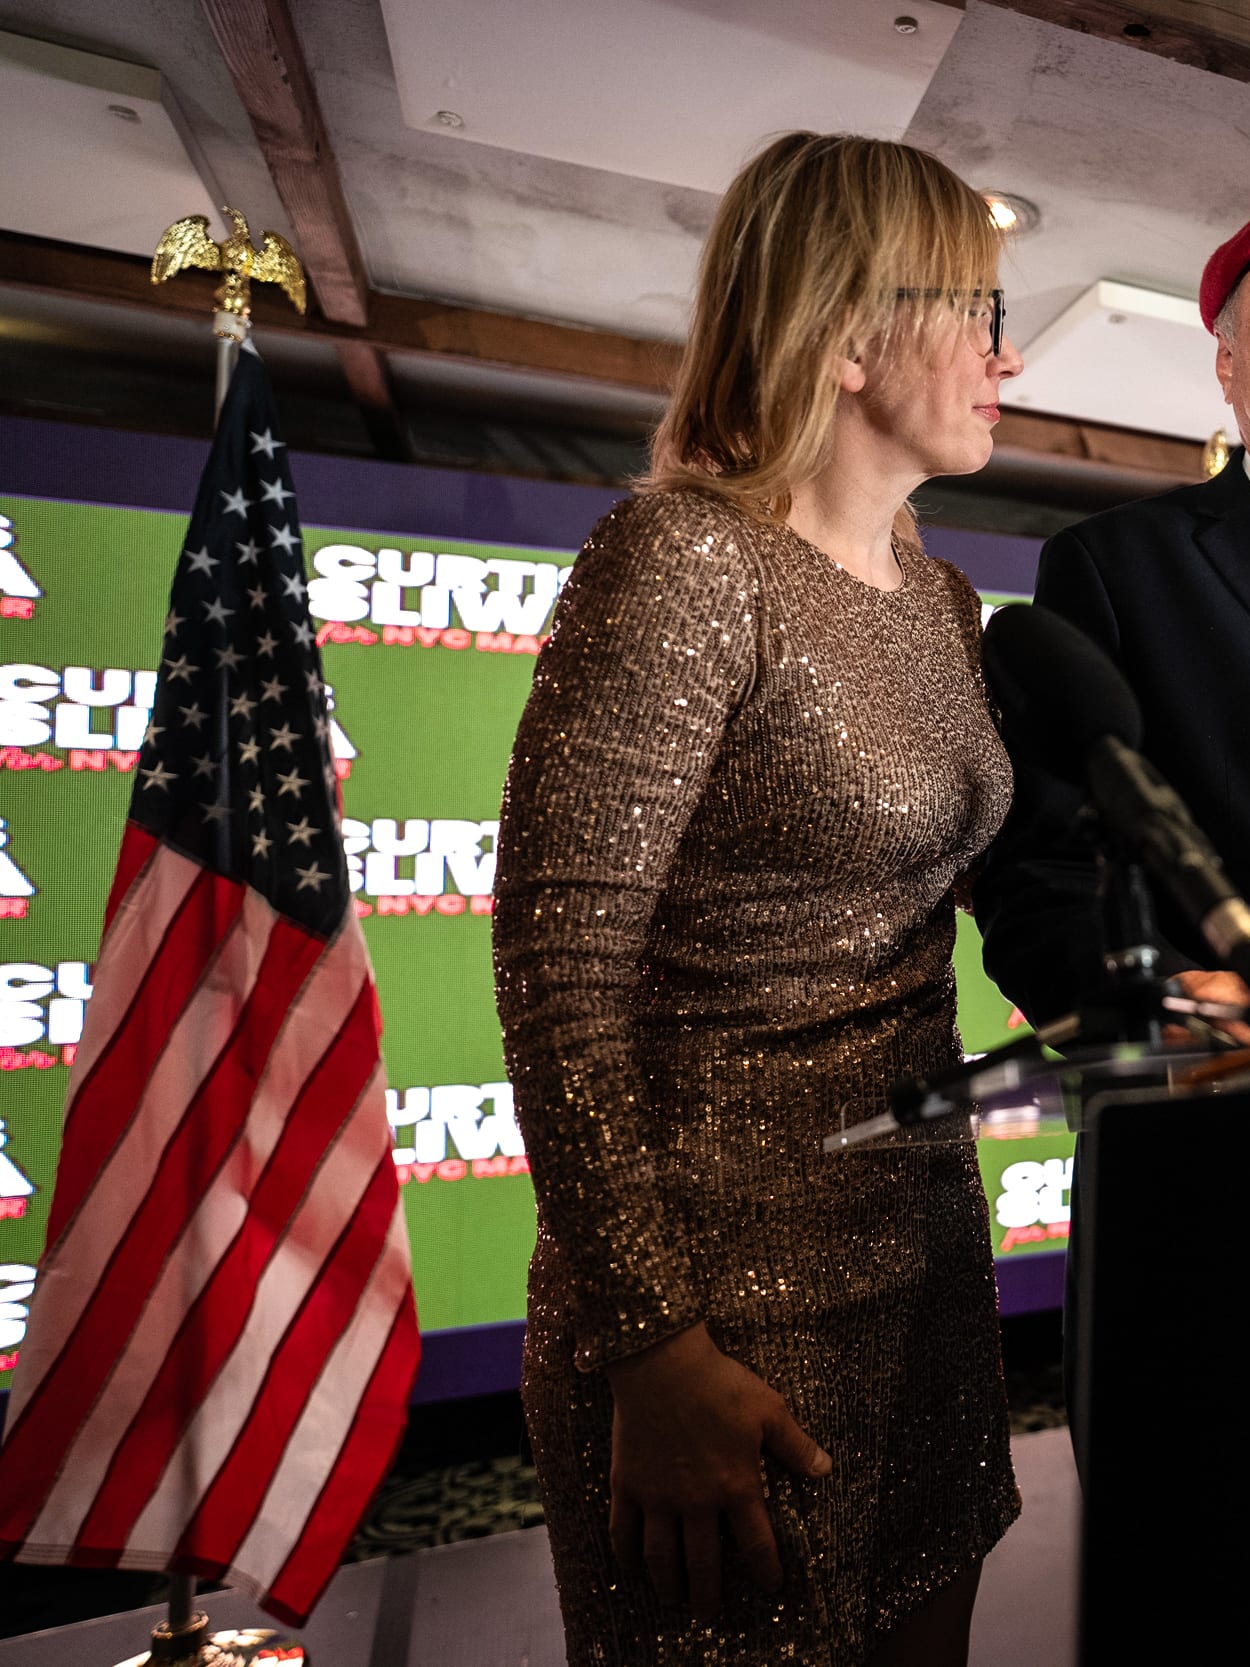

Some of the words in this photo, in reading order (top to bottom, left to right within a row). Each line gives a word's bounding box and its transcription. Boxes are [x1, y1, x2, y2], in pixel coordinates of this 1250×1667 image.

[313, 544, 575, 596] CURTI
[382, 625, 471, 650] NYC
[475, 631, 551, 655] MA
[376, 894, 467, 917] NYC
